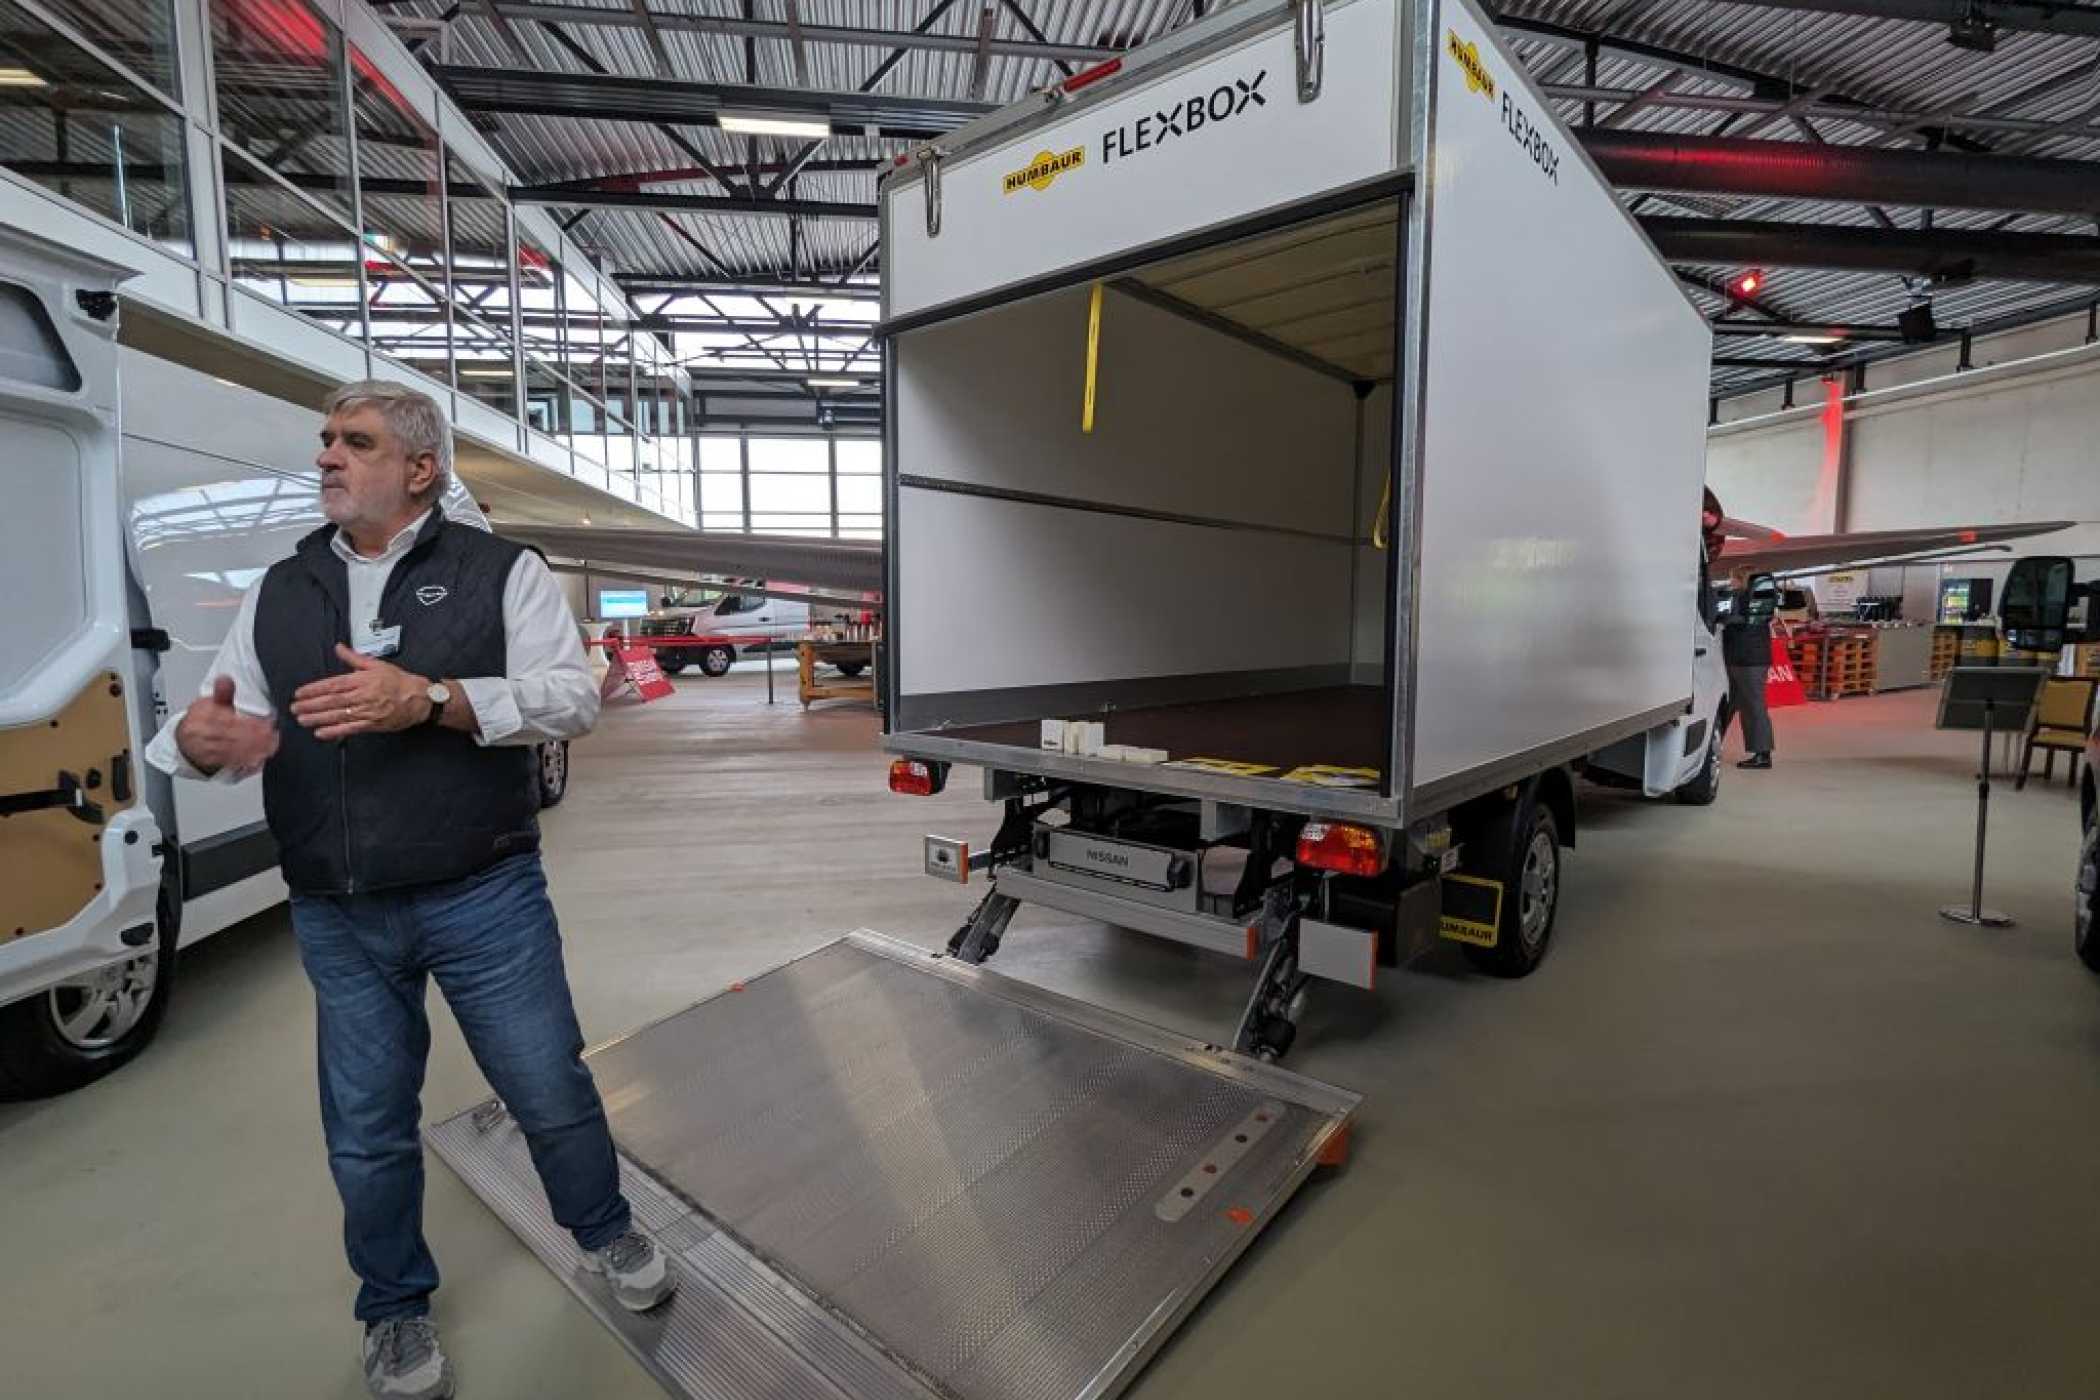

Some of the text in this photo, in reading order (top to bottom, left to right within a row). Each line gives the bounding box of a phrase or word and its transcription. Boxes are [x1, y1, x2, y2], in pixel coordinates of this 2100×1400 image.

[1006, 70, 1267, 191] HUMBAUR FLEXBOX
[1450, 35, 1559, 186] HUMBAUR FLEXBOX
[1086, 848, 1128, 866] NISSAN
[1440, 920, 1495, 944] UMBAUR
